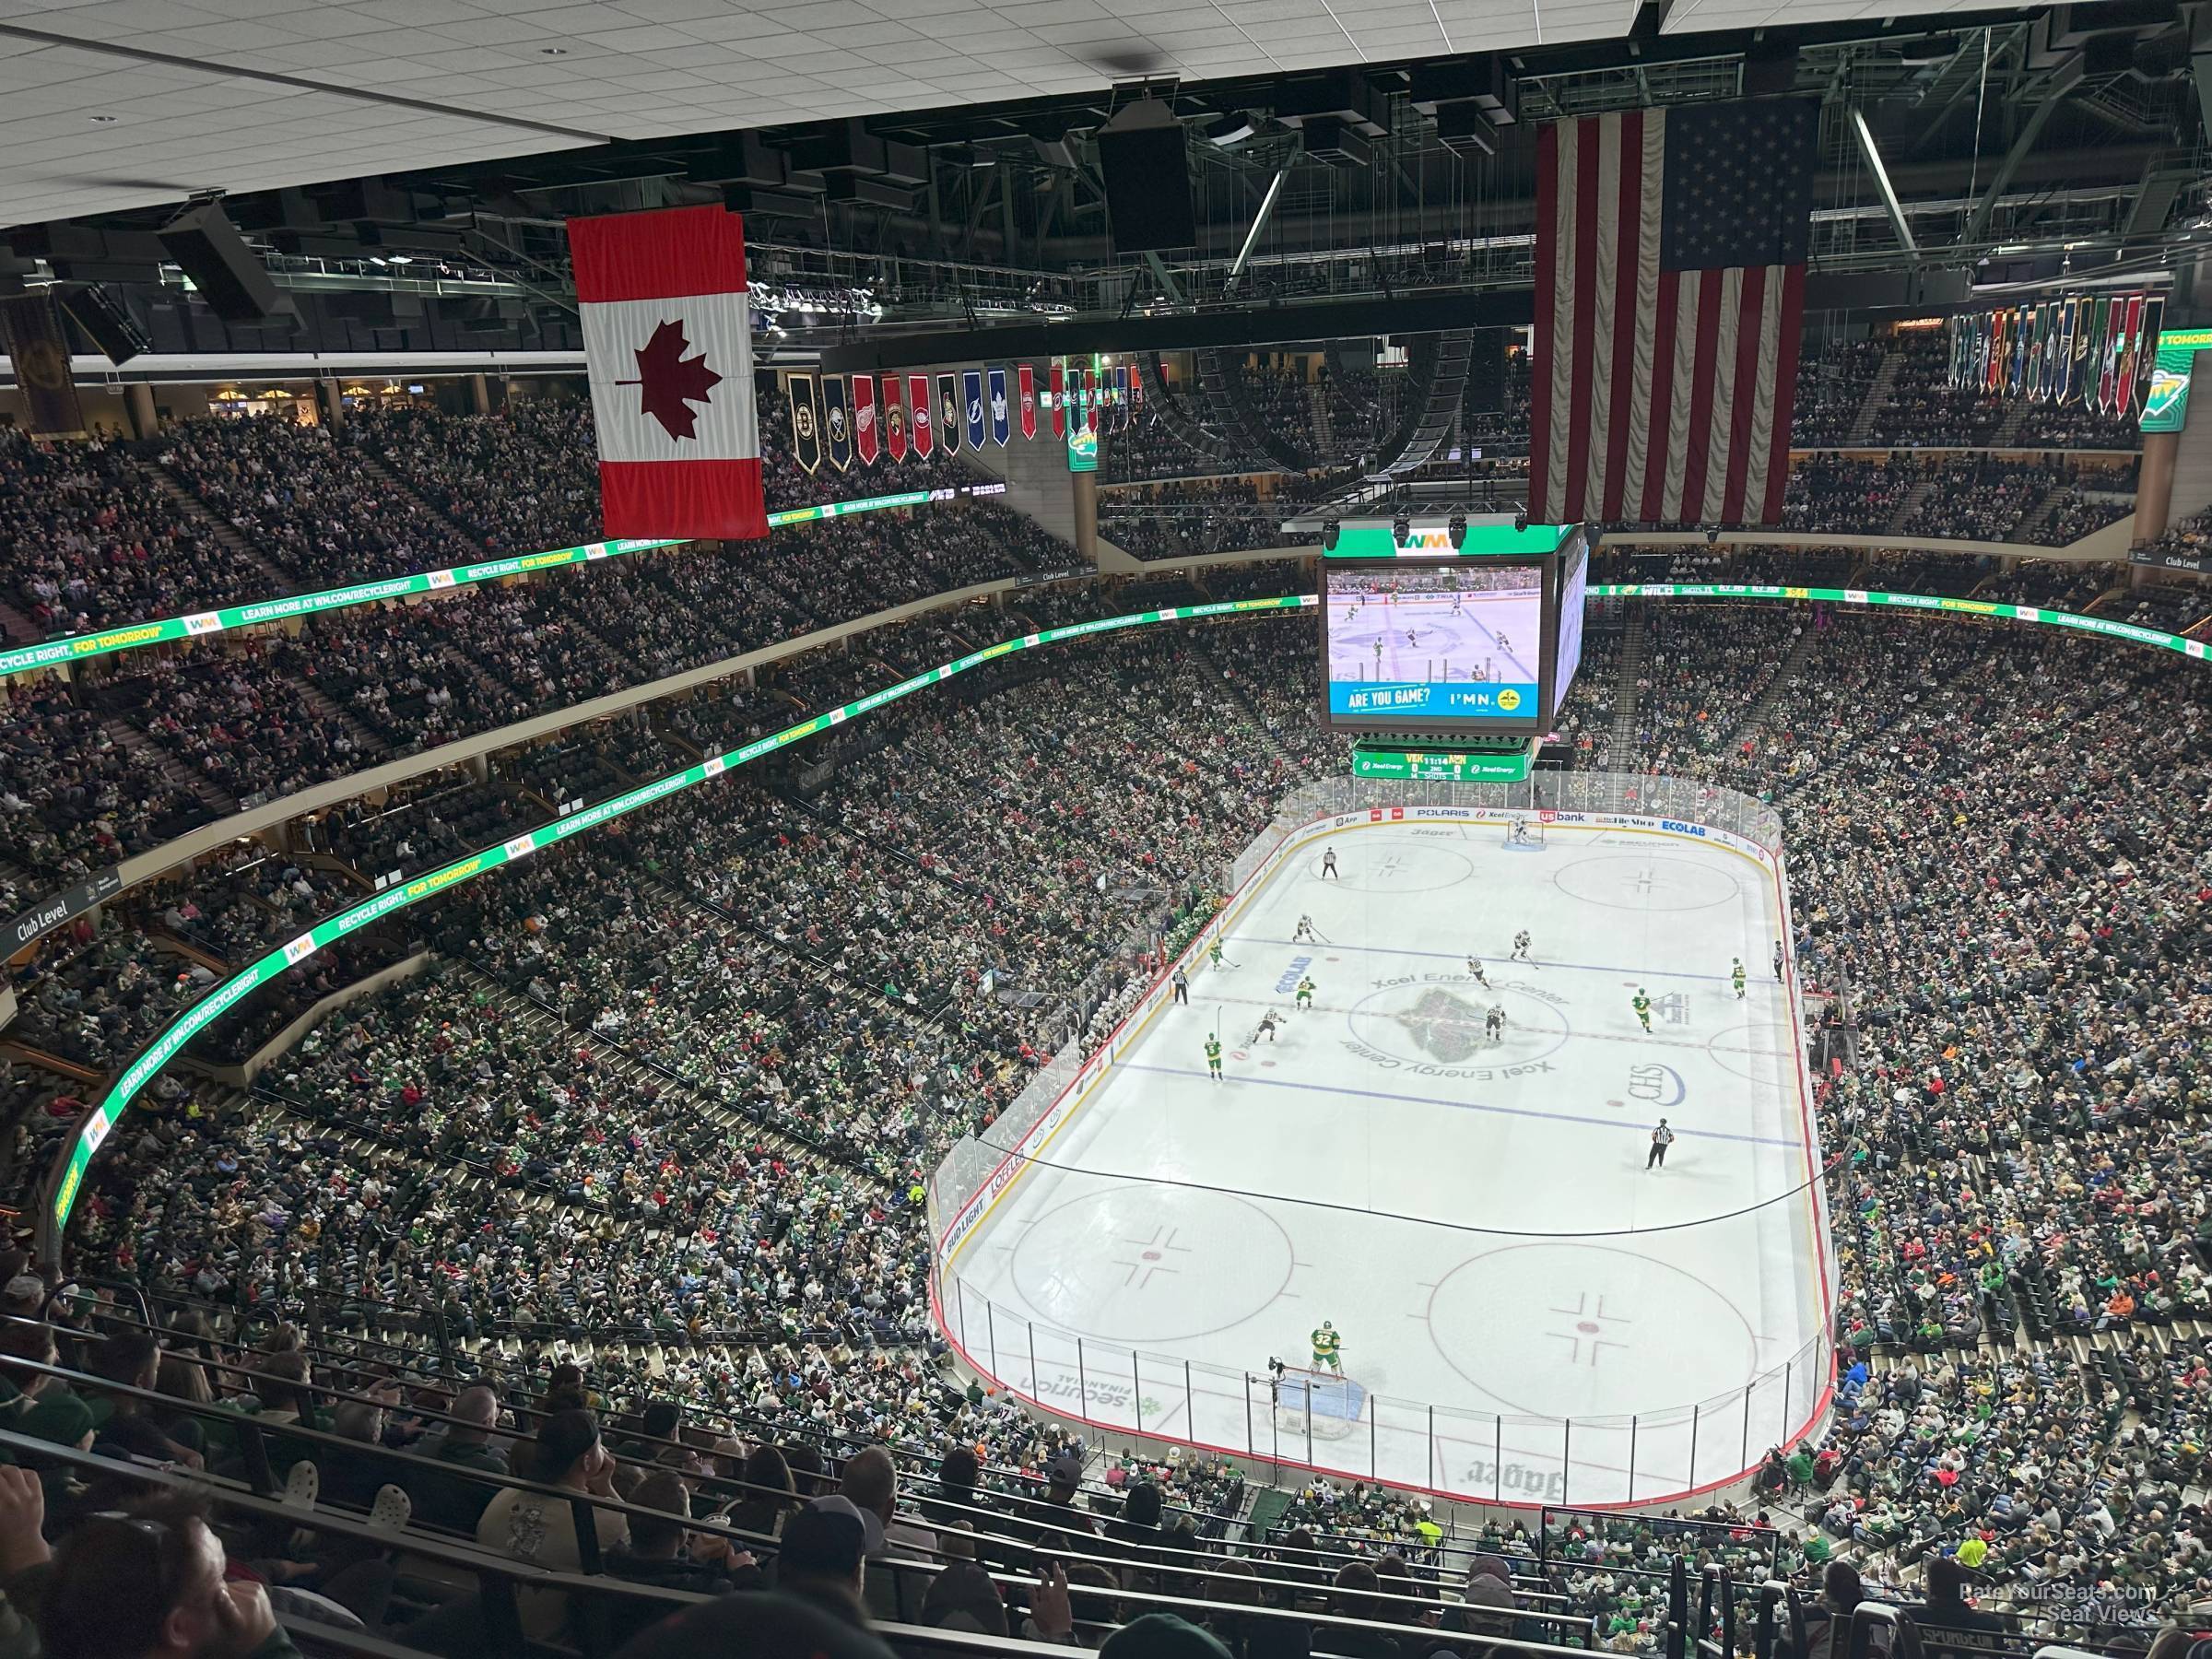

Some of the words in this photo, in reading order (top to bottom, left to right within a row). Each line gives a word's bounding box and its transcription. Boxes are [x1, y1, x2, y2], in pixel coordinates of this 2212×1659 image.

[432, 574, 452, 584] WM
[468, 564, 499, 578] RECYCLE
[500, 561, 521, 573] RIGHT,
[522, 559, 535, 569] FOR
[2166, 557, 2182, 566] Club
[2183, 559, 2200, 570] Level
[190, 618, 217, 629] WM
[241, 606, 273, 620] LEARN
[275, 602, 300, 616] MORE
[302, 599, 313, 610] AT
[313, 581, 412, 606] WM.COM/RECYCLERIGHT
[1193, 606, 1216, 614] RECYCLE
[1888, 595, 1918, 605] RECYCLE
[1941, 600, 1956, 608] FOR
[2057, 614, 2077, 625] LEARN
[2078, 618, 2096, 629] MORE
[2097, 621, 2105, 630] AT
[38, 645, 73, 662] RIGHT,
[74, 641, 97, 653] FOR
[1348, 693, 1368, 708] ARE
[1371, 691, 1392, 706] YOU
[1394, 688, 1430, 703] GAME?
[739, 741, 762, 759] RECYCLE
[779, 733, 789, 743] FOR
[1412, 763, 1418, 772] 0
[1453, 764, 1461, 774] 0
[510, 840, 530, 853] WM
[557, 818, 581, 834] LEARN
[582, 810, 602, 826] MORE
[602, 806, 611, 818] AT
[612, 775, 687, 813] WM.COM/RECYCLERIGHT
[1345, 817, 1358, 825] App
[1418, 808, 1469, 818] POLARIS
[1540, 812, 1555, 821] us
[1557, 811, 1585, 822] bank
[1662, 820, 1706, 837] ECOLAB
[18, 918, 39, 941] Club
[38, 900, 68, 928] Level
[289, 939, 312, 958] WM
[338, 904, 377, 931] RECYCLE
[378, 891, 406, 912] RIGHT,
[407, 883, 427, 897] FOR
[1371, 974, 1416, 990] Xcel
[1505, 980, 1571, 1006] Center
[1639, 999, 1645, 1008] 7
[120, 1066, 144, 1099] LEARN
[144, 1047, 164, 1071] MORE
[162, 1039, 173, 1053] AT
[172, 969, 259, 1044] WM.COM/RECYCLERIGHT
[1208, 1044, 1216, 1054] 5
[1339, 1039, 1401, 1069] Center
[1406, 1062, 1493, 1081] Energy
[1503, 1060, 1557, 1080] Xcel
[1628, 1064, 1664, 1100] CHS
[991, 1149, 1025, 1194] LOFFLER
[947, 1226, 963, 1253] BUD
[961, 1198, 984, 1232] LIGHT
[1315, 1335, 1331, 1346] 32
[1019, 1376, 1128, 1407] securian
